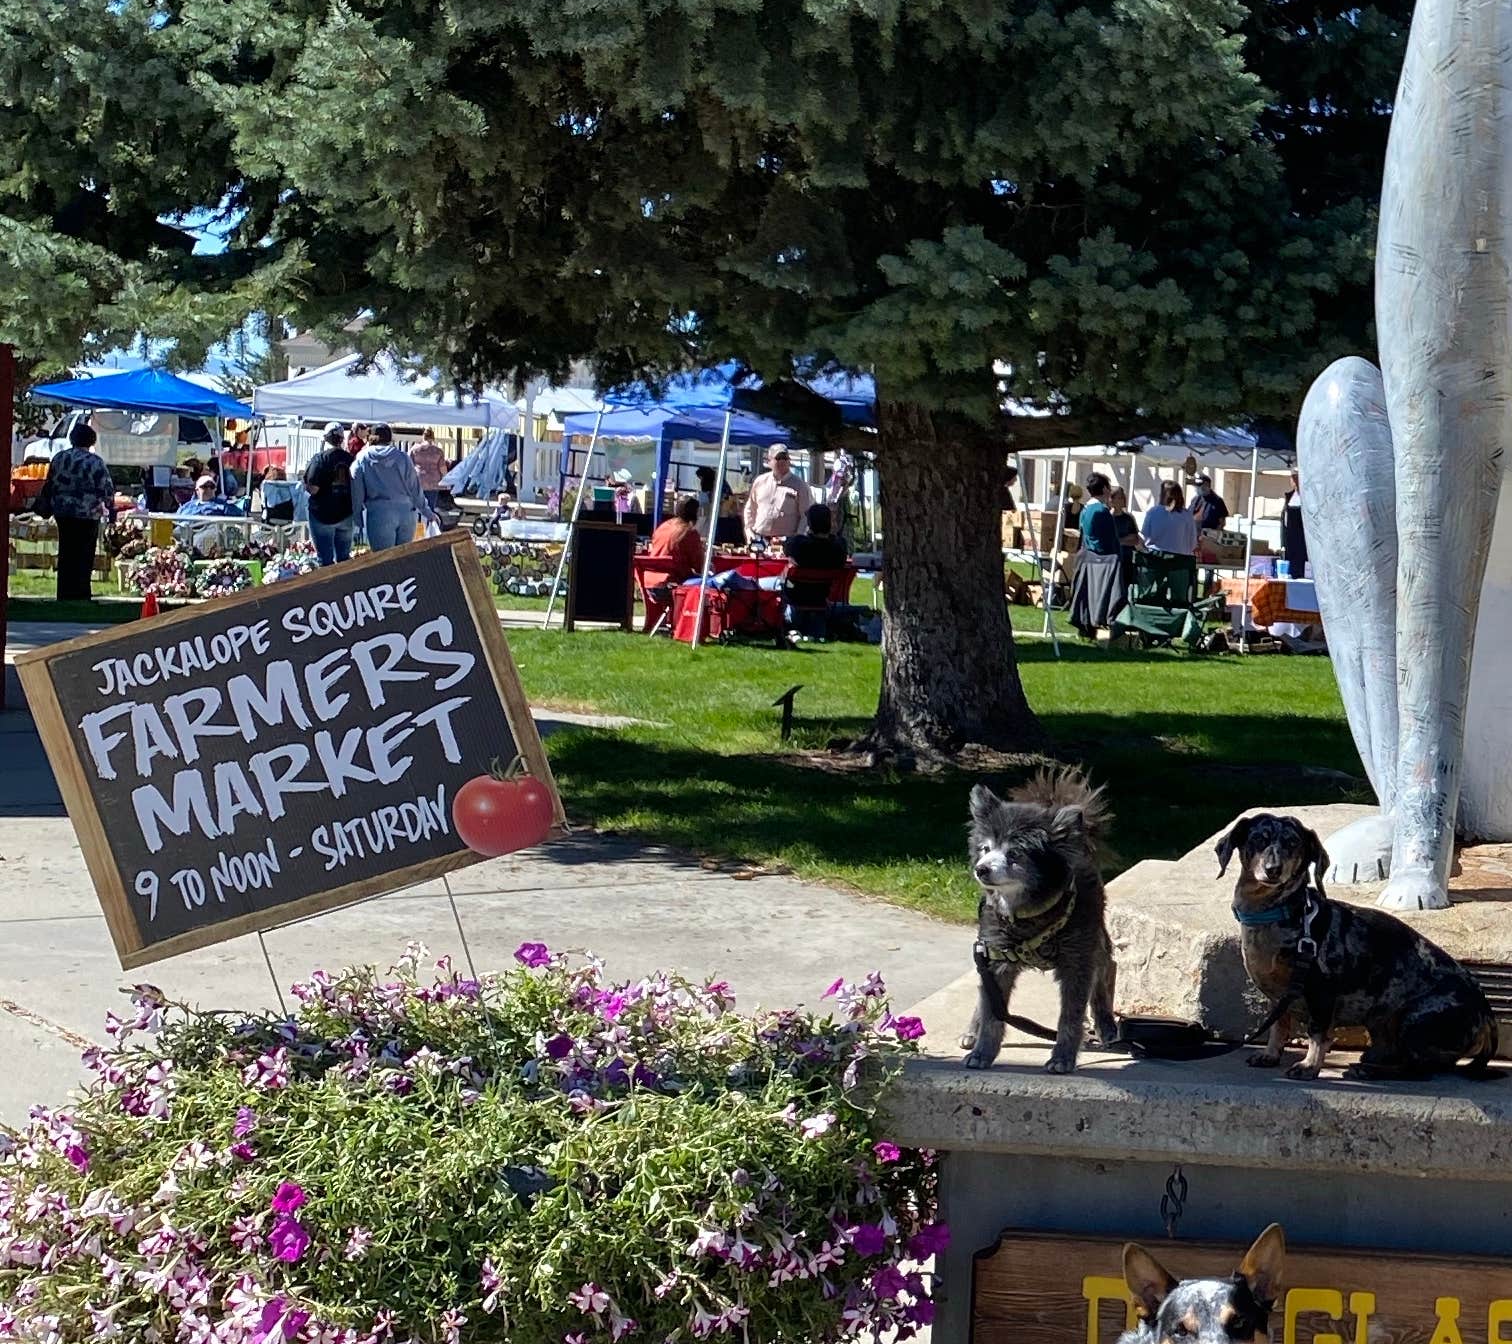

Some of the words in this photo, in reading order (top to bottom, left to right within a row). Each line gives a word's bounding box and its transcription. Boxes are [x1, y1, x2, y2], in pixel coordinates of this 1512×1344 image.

[78, 615, 476, 781] FARMERS
[92, 619, 271, 696] JACKALOPE
[281, 577, 418, 643] SQUARE
[131, 696, 472, 854] MARKET
[134, 870, 159, 922] 9
[169, 869, 206, 910] TO
[210, 837, 281, 902] NOON
[311, 783, 449, 871] SATURDAY
